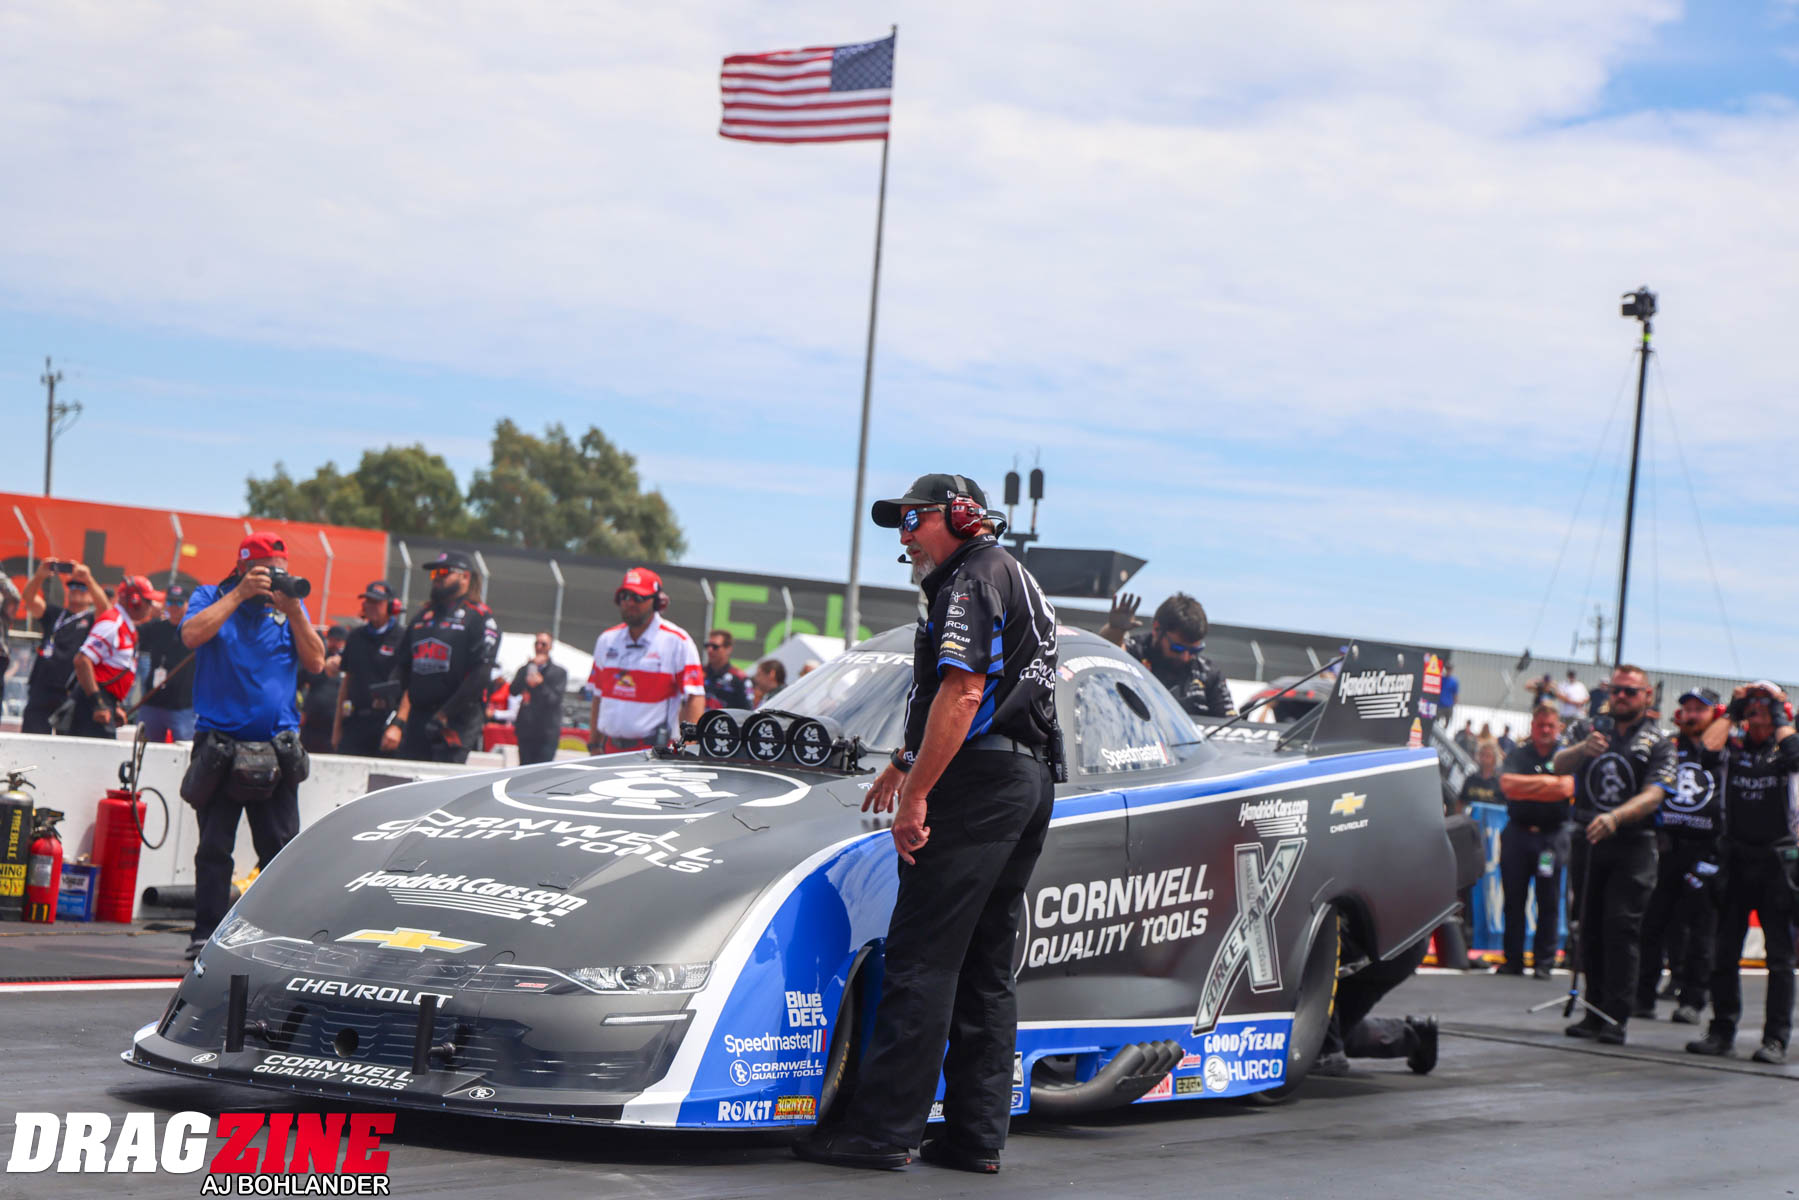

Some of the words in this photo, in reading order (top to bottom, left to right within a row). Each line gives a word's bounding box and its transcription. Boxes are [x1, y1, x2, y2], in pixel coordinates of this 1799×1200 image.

[377, 809, 714, 863] CORNWELL
[1330, 819, 1368, 834] CHEVROLET
[352, 826, 547, 842] QUALITY
[557, 836, 709, 873] TOOLS
[1035, 864, 1208, 928] CORNWELL
[1028, 921, 1134, 968] QUALITY
[1141, 908, 1208, 947] TOOLS
[1204, 936, 1241, 1015] FORCE
[1238, 854, 1285, 943] FAMILY
[785, 991, 822, 1008] Blue
[788, 1008, 823, 1027] DEF
[724, 1032, 812, 1057] Speedmaster
[1204, 1027, 1285, 1057] GOODYEAR
[253, 1064, 337, 1080] QUALITY
[341, 1074, 408, 1090] TOOLS
[264, 1055, 410, 1082] CORNWELL
[752, 1060, 822, 1072] CORNWELL
[752, 1071, 790, 1080] QUALITY
[793, 1069, 823, 1078] TOOLS
[1227, 1059, 1283, 1081] HURCO
